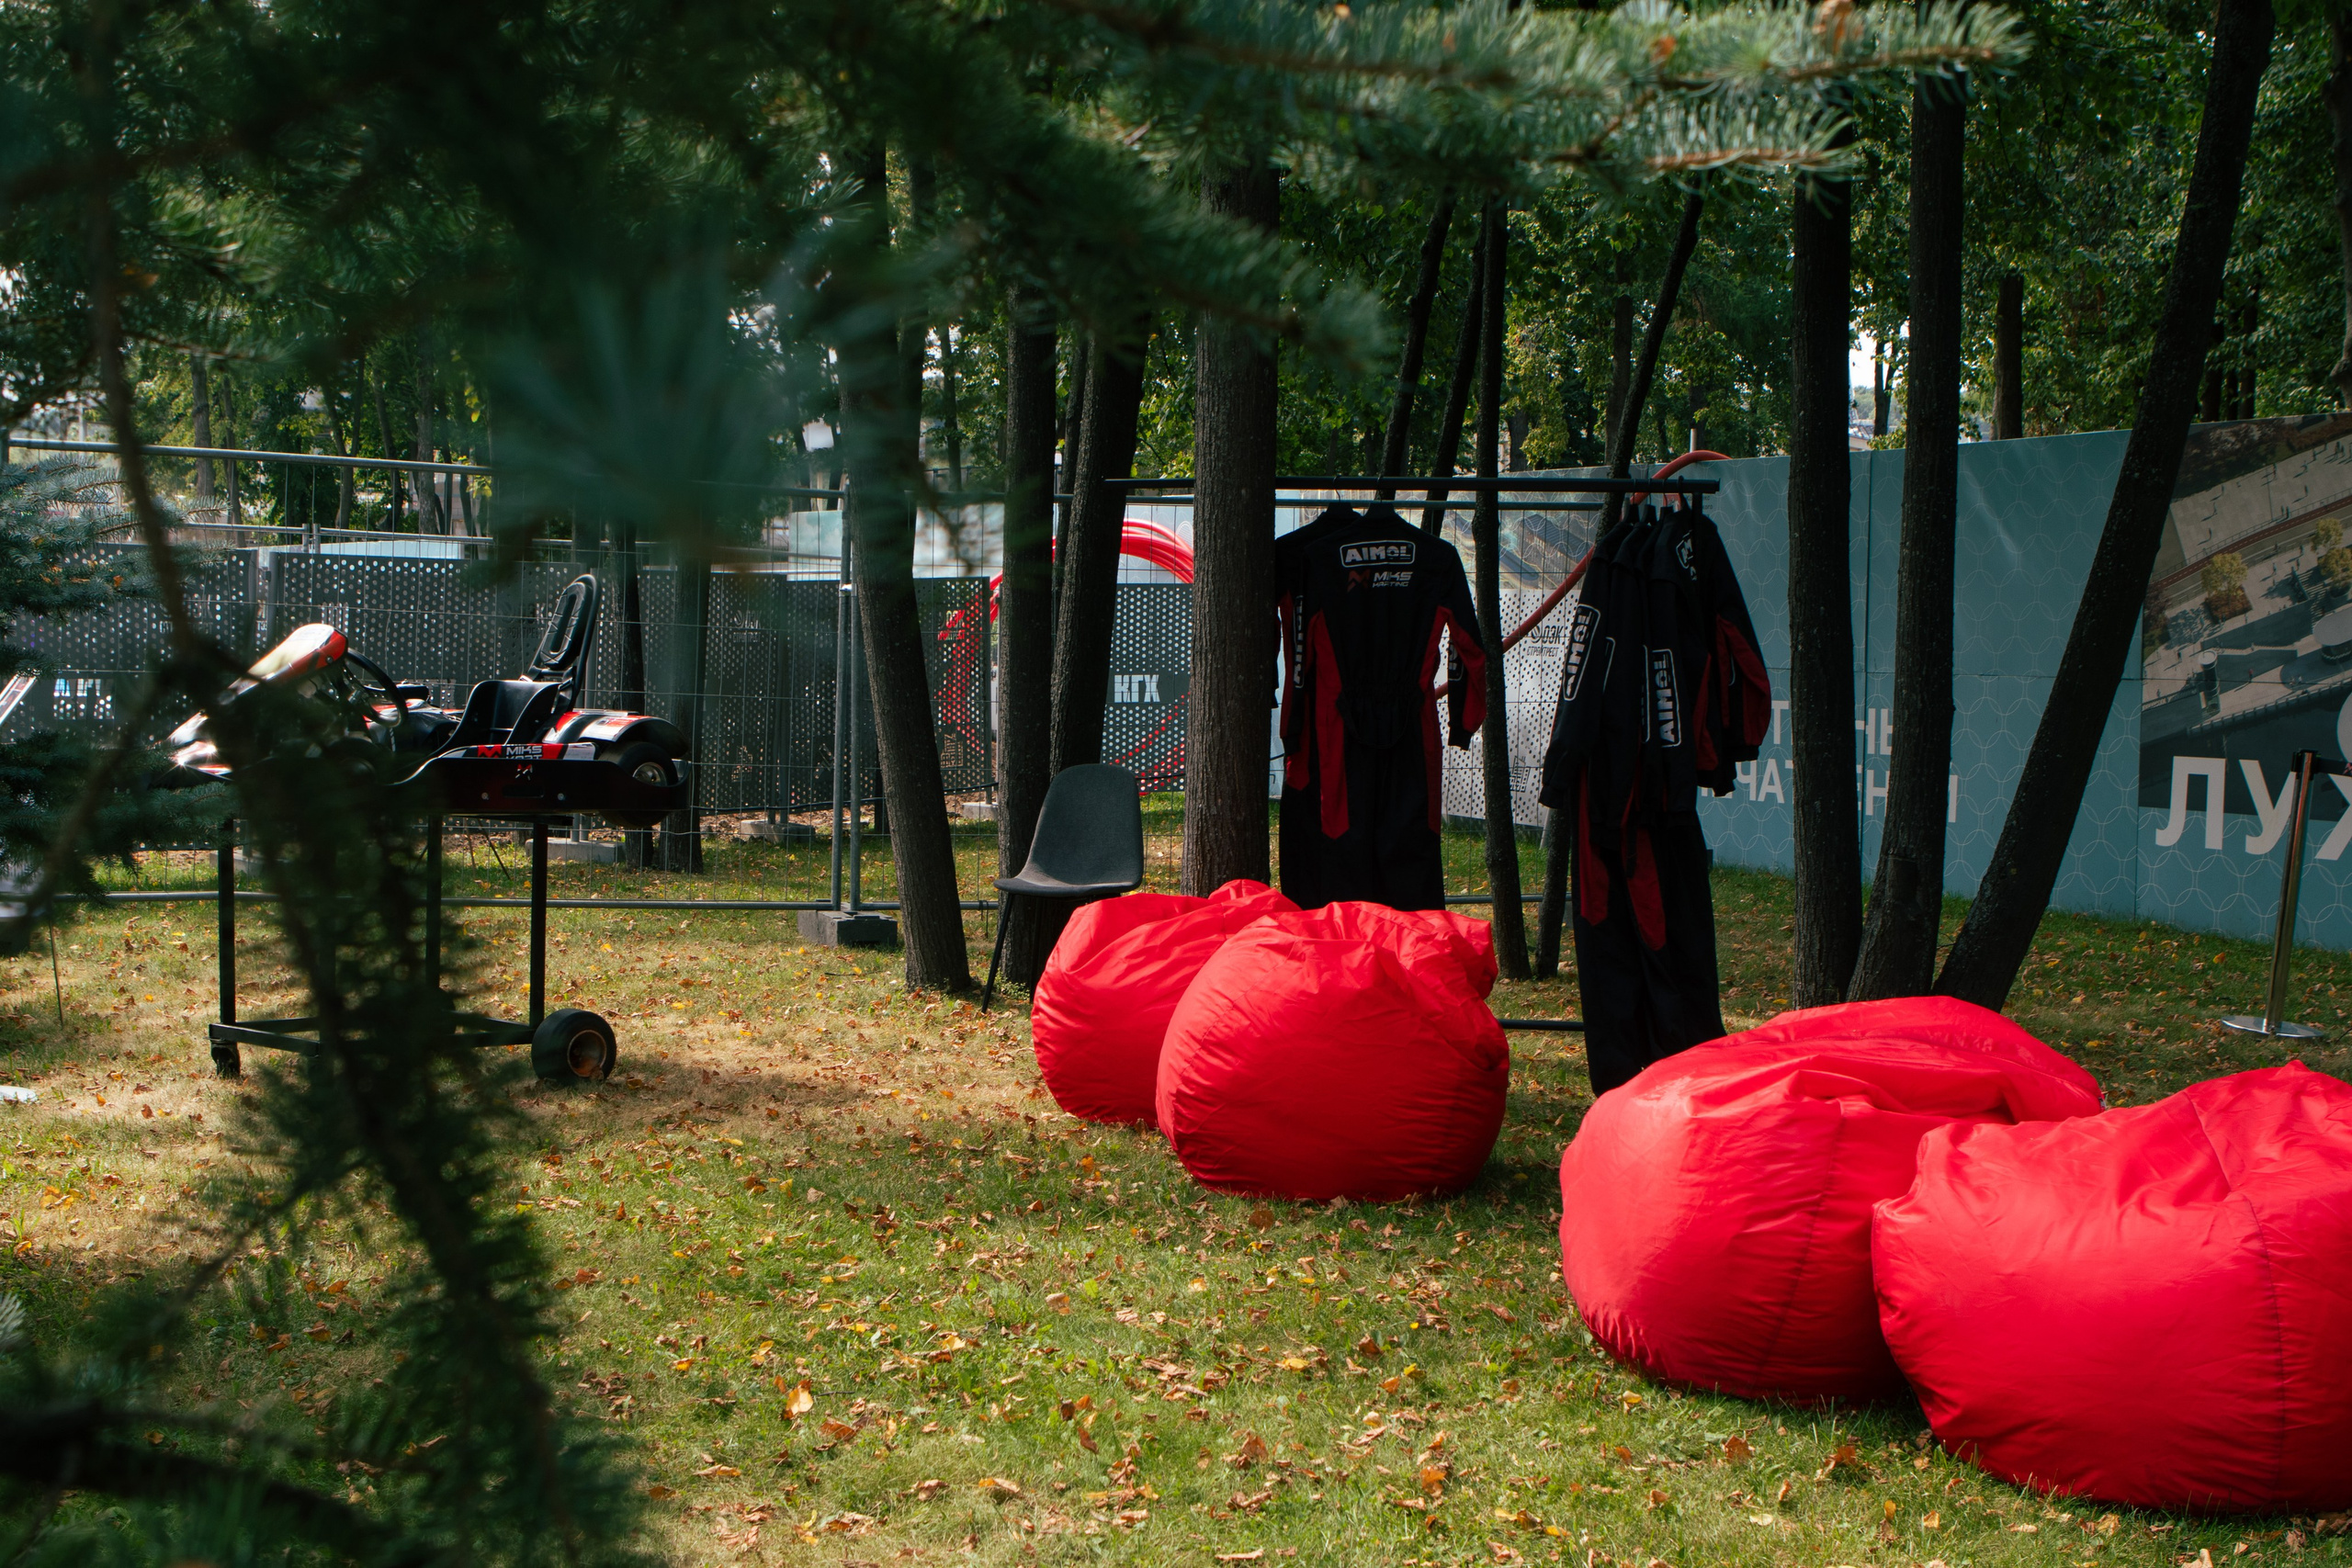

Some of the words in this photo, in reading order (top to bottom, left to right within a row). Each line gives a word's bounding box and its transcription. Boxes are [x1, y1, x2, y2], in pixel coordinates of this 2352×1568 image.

[1344, 545, 1411, 563] AIMOL
[1373, 570, 1414, 581] MIKS
[1114, 674, 1160, 703] КГХ
[1653, 653, 1676, 743] AIMOL
[505, 745, 542, 755] MIKS
